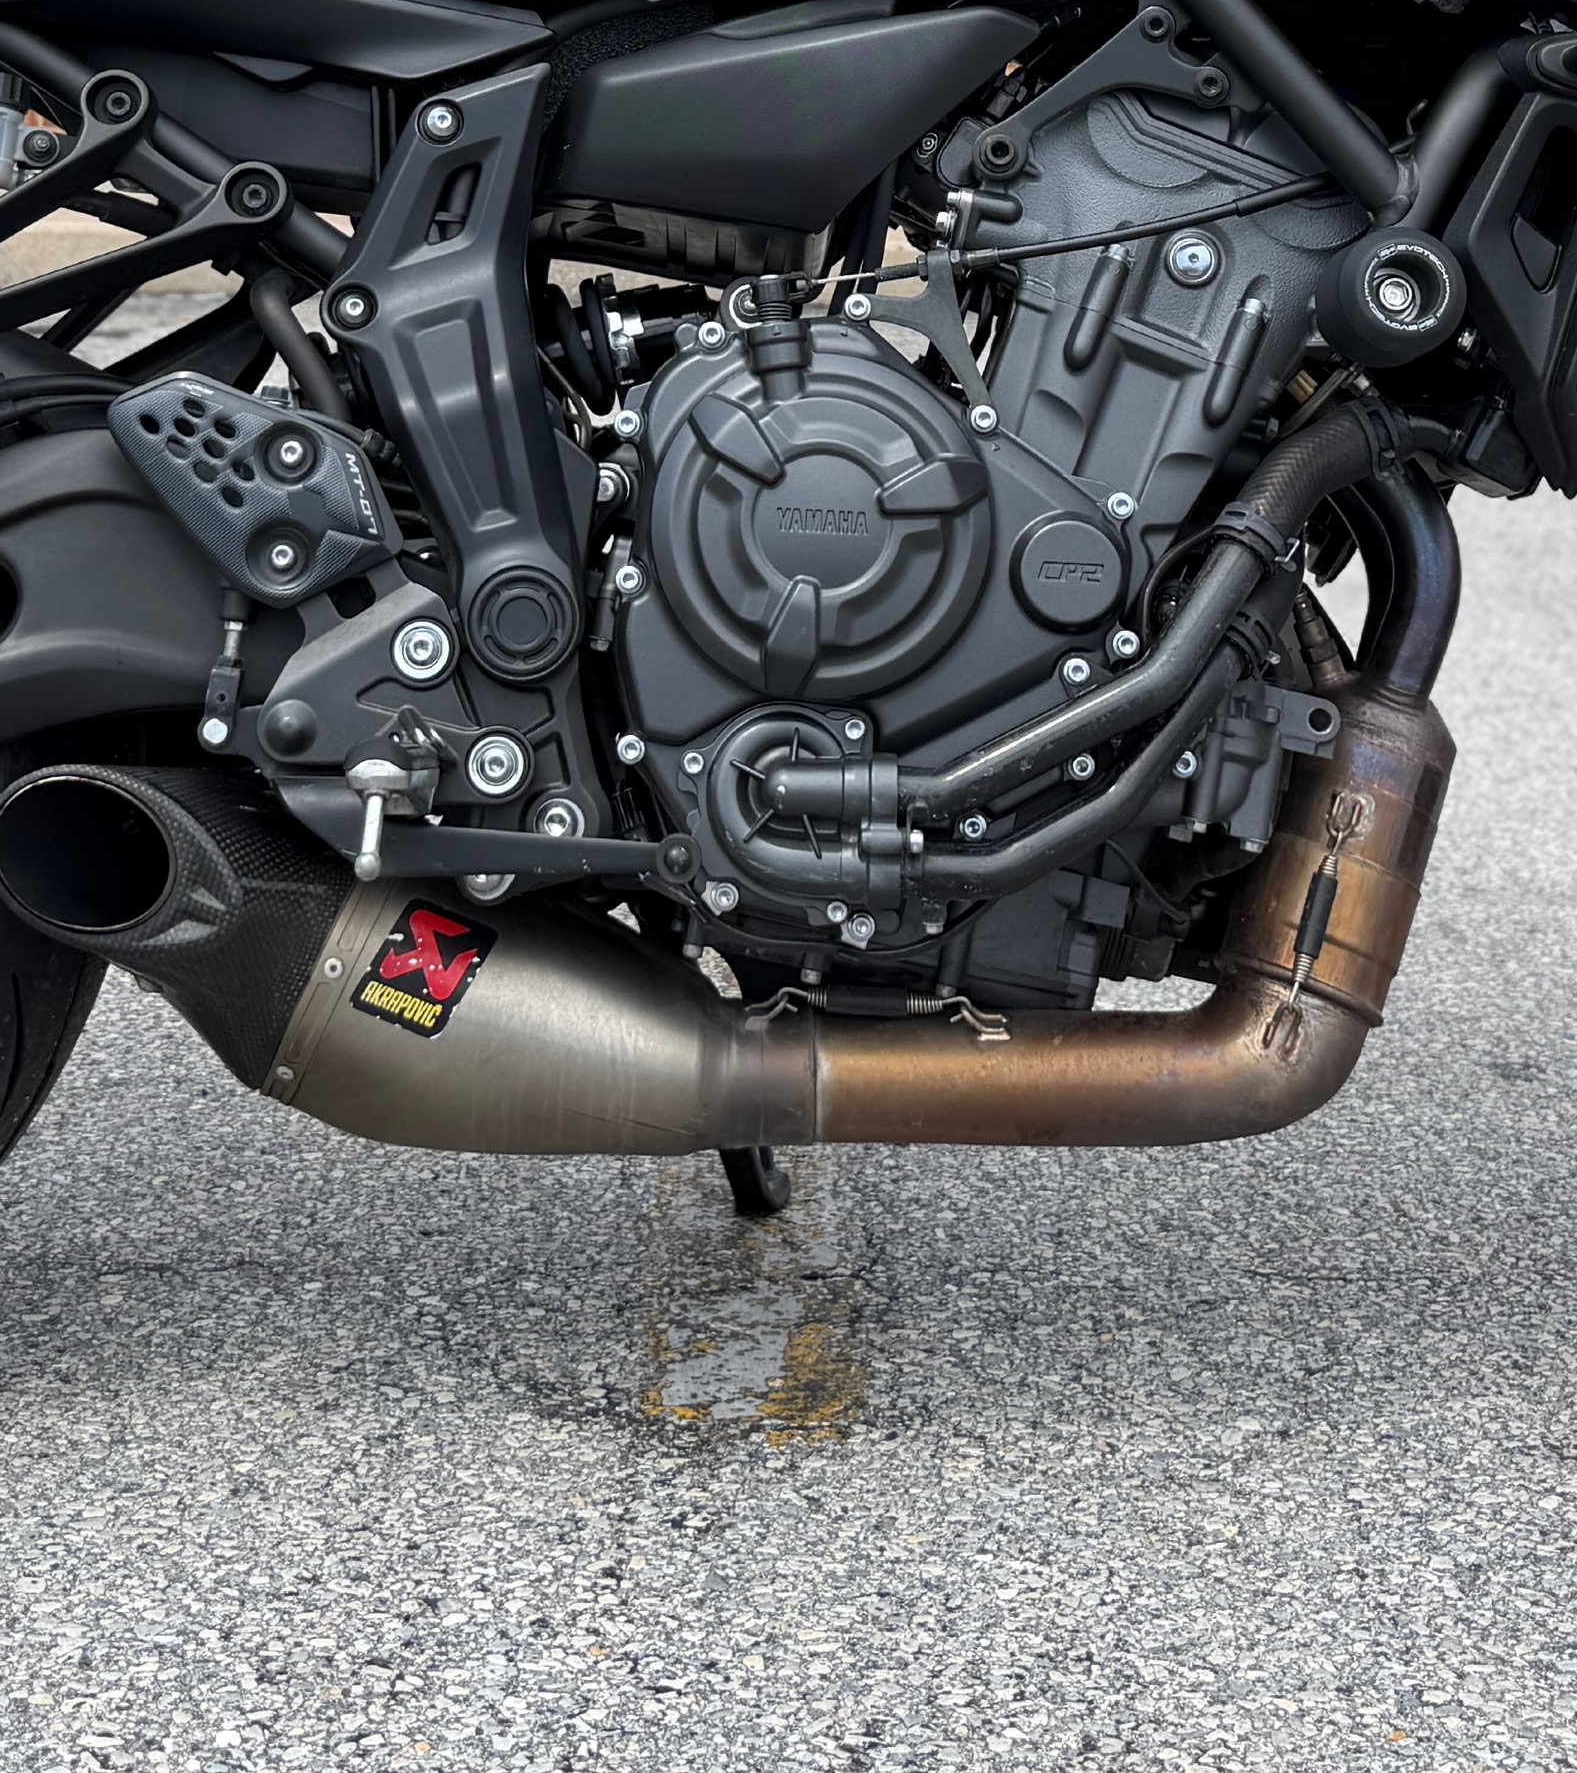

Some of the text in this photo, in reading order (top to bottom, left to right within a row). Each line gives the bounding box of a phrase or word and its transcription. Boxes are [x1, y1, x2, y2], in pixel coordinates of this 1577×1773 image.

[345, 452, 379, 536] MT-07
[776, 506, 870, 537] YAMAHA
[1036, 559, 1105, 585] CP2
